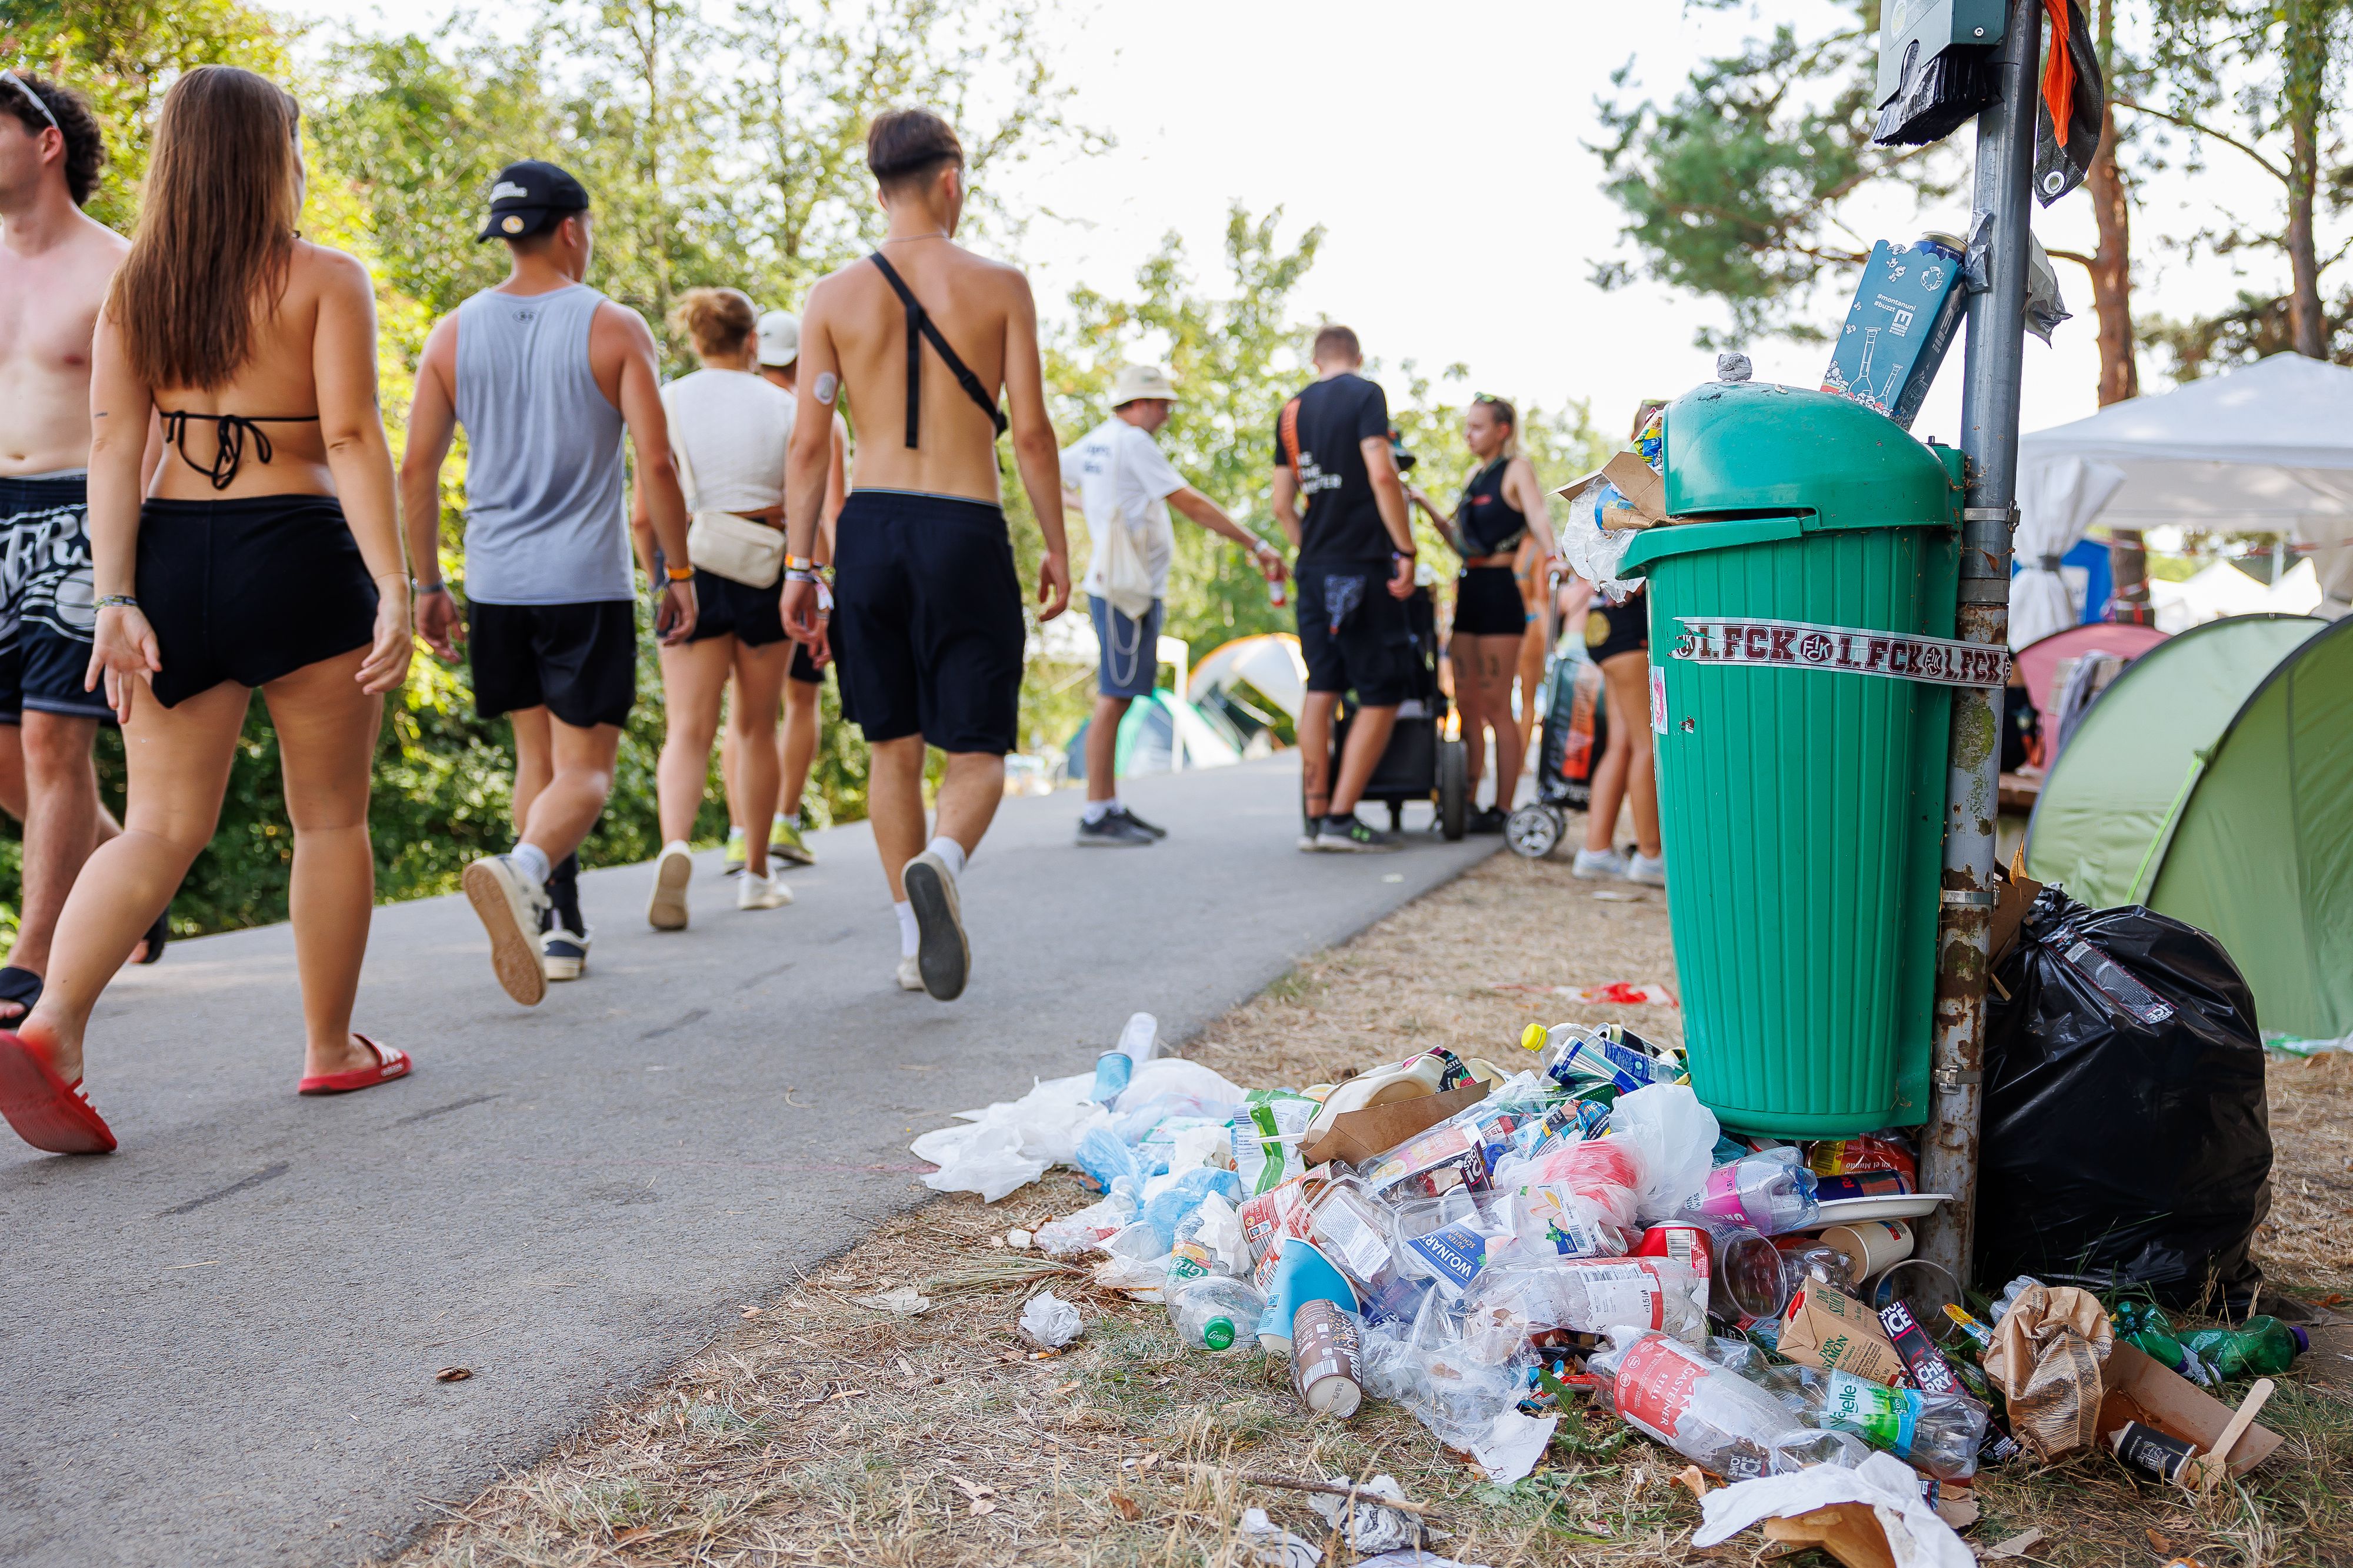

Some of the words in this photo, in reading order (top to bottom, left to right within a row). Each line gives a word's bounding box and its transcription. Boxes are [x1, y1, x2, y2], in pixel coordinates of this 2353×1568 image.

[1874, 301, 1896, 312] #buzzt
[1877, 293, 1917, 312] #montanuni
[1722, 625, 1798, 662] FCK
[1865, 638, 1924, 676] FCK
[1959, 648, 2001, 683] FCK
[2147, 1005, 2170, 1021] ICE
[1446, 1233, 1466, 1250] PUTEN
[1817, 1287, 1829, 1304] DON
[1828, 1289, 1845, 1317] SIMON
[1882, 1306, 1912, 1337] ICE
[1818, 1337, 1836, 1359] DON
[1822, 1333, 1849, 1369] SIMON
[1844, 1345, 1856, 1362] Blanco
[1913, 1360, 1924, 1370] WILD
[1651, 1373, 1669, 1400] STILL
[1660, 1367, 1697, 1426] GASTEINER
[1727, 1453, 1741, 1477] SHOT
[1739, 1457, 1762, 1479] ICE
